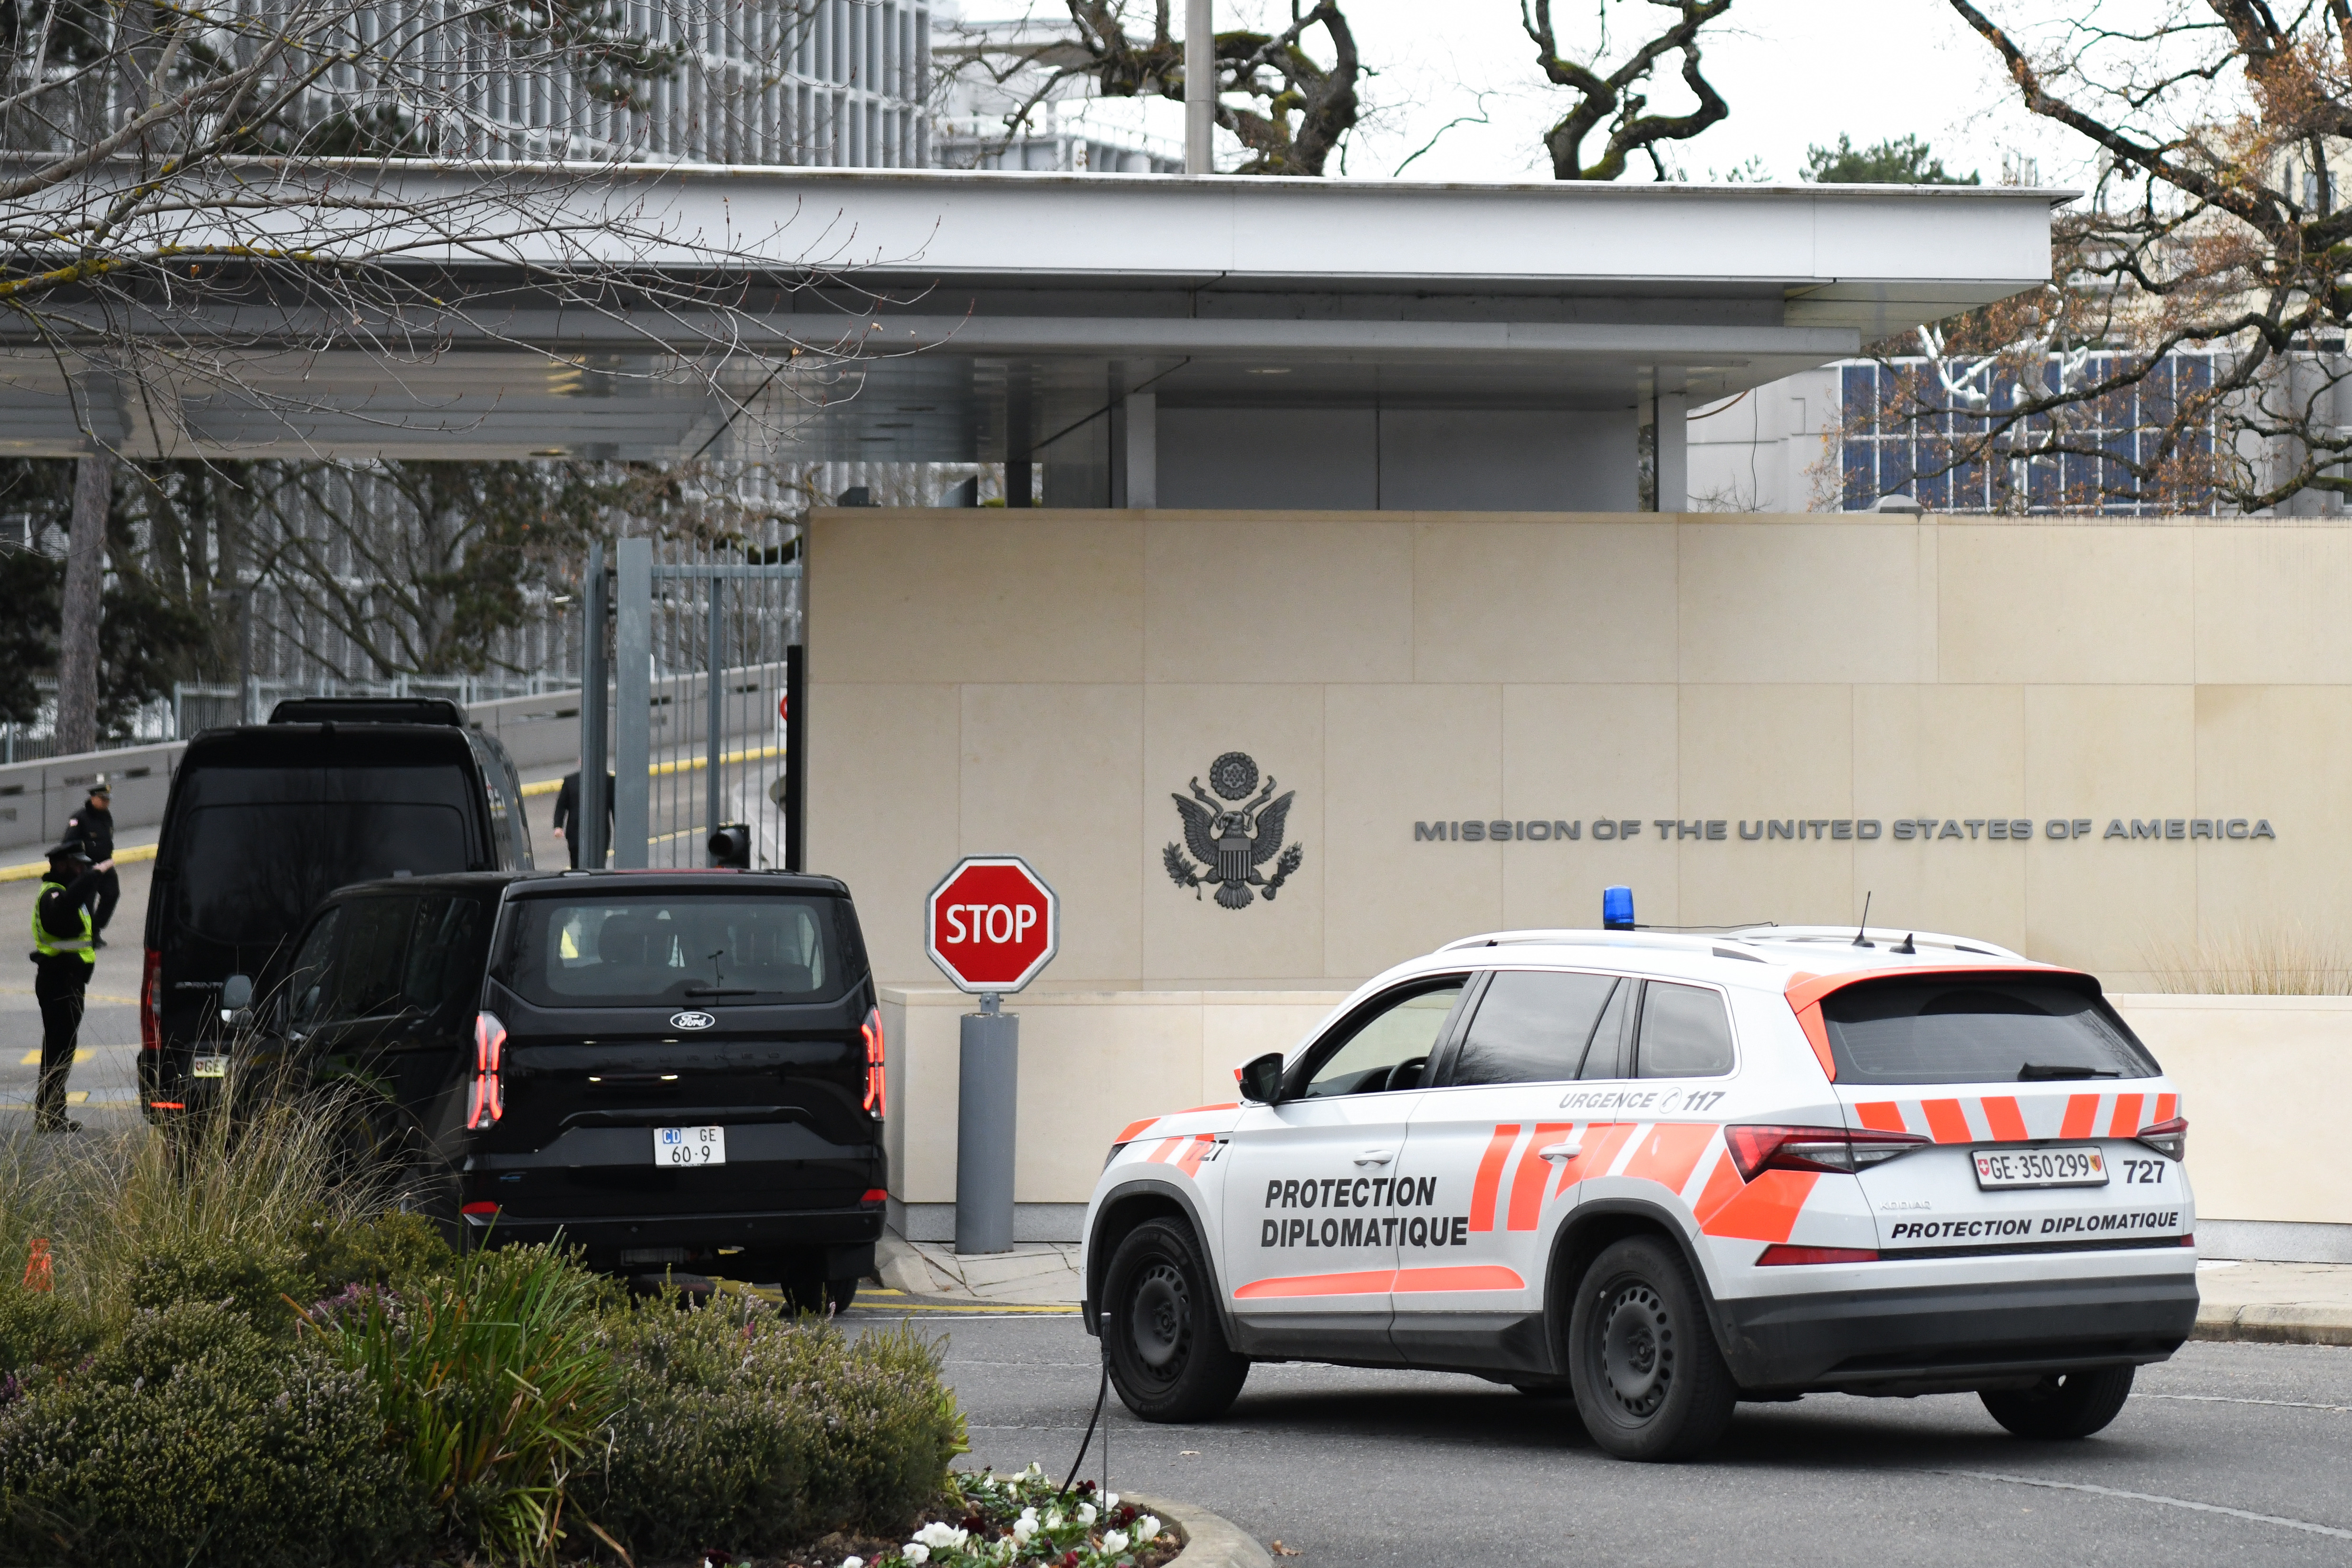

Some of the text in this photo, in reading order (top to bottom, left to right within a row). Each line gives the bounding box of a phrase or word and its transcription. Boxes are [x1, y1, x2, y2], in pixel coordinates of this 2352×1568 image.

[1415, 819, 2276, 841] MISSION OF THE UNITED STATES OF AMERICA
[946, 904, 1037, 944] STOP
[679, 1014, 707, 1026] Ford
[204, 1059, 221, 1073] GE
[1558, 1091, 1726, 1111] URGENCE 117
[663, 1128, 717, 1144] CD GE
[1186, 1139, 1230, 1161] 727
[2123, 1160, 2166, 1184] 727
[1265, 1176, 1437, 1208] PROTECTION
[1879, 1200, 1932, 1210] KODIAQ
[1261, 1217, 1469, 1249] DIPLOMATIQUE
[1891, 1212, 2179, 1239] PROTECTION DIPLOMATIQUE
